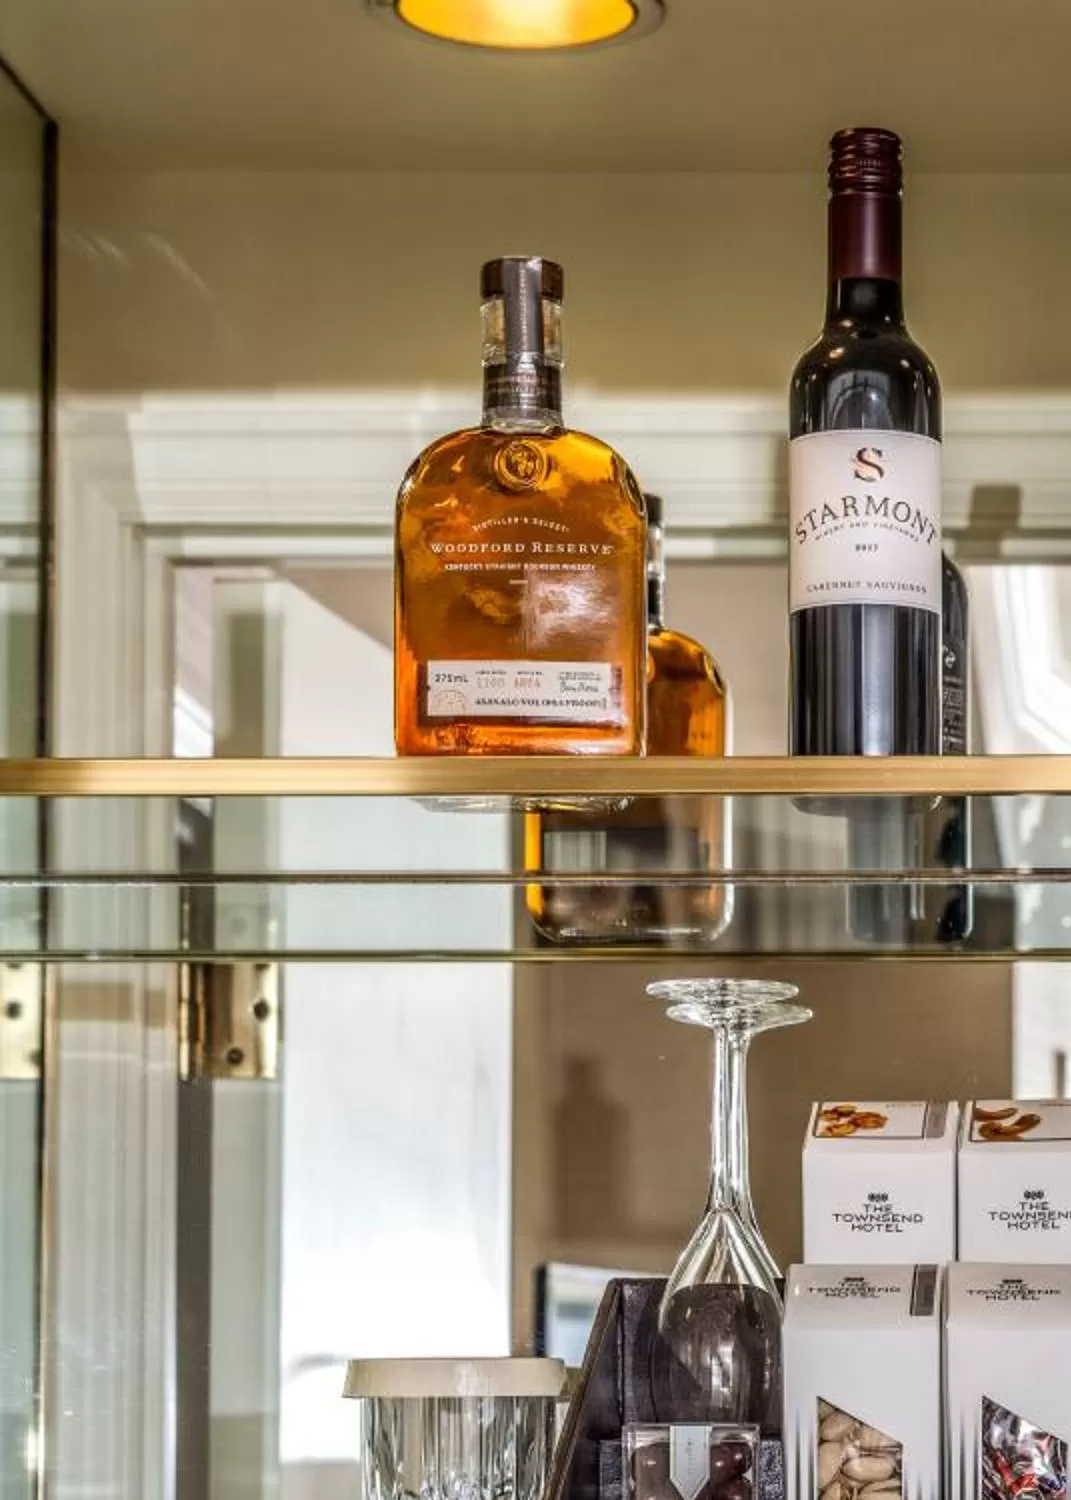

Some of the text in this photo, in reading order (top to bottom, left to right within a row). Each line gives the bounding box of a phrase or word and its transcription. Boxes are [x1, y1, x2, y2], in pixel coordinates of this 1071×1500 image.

[853, 447, 885, 483] S
[795, 495, 938, 545] STARMONT
[430, 541, 615, 556] WOODFORD RESERVE
[863, 1203, 894, 1213] THE
[1019, 1202, 1050, 1211] THE
[831, 1213, 925, 1224] TOWNSEND
[851, 1223, 904, 1233] HOTEL
[1007, 1220, 1061, 1230] HOTEL
